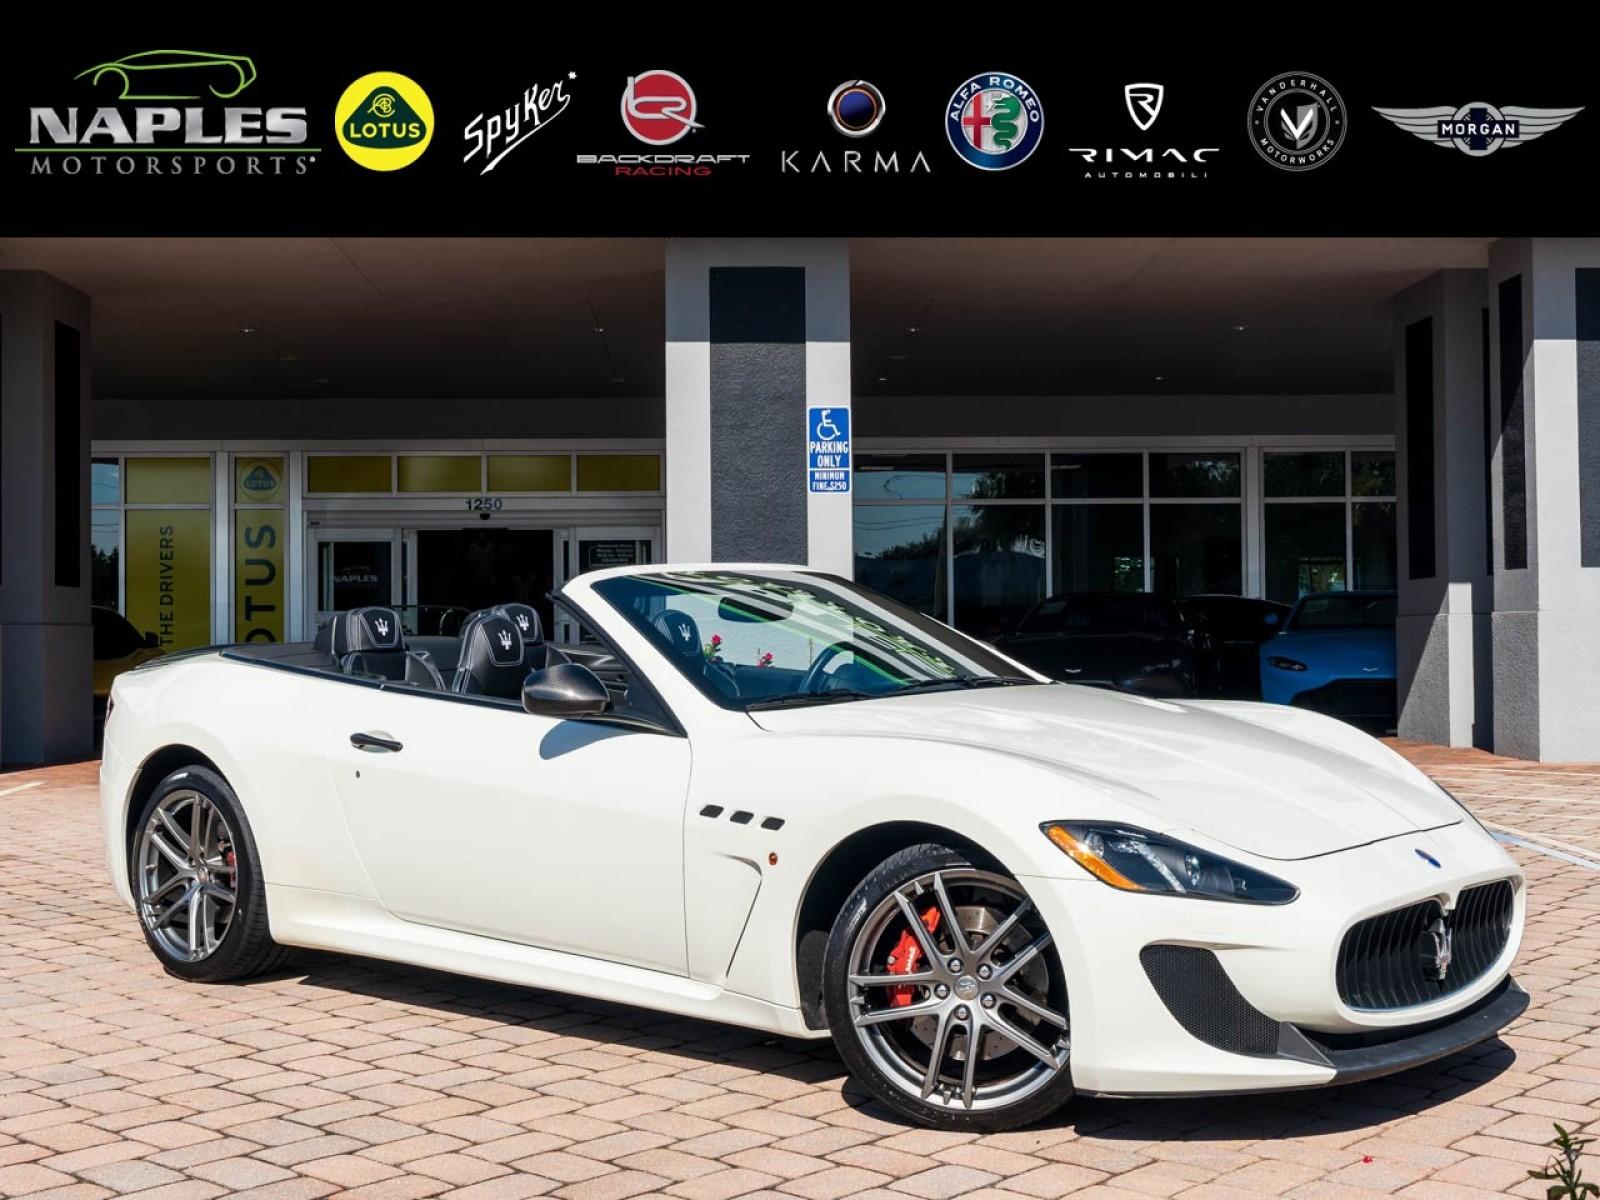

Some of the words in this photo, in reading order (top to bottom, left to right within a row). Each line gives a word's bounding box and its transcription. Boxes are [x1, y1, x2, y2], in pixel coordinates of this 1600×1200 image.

[810, 441, 848, 453] PARKING
[817, 455, 842, 466] ONLY
[814, 471, 845, 480] MINIMUM
[465, 498, 503, 511] 1250
[159, 525, 175, 604] DRIVERS
[159, 610, 175, 647] THE
